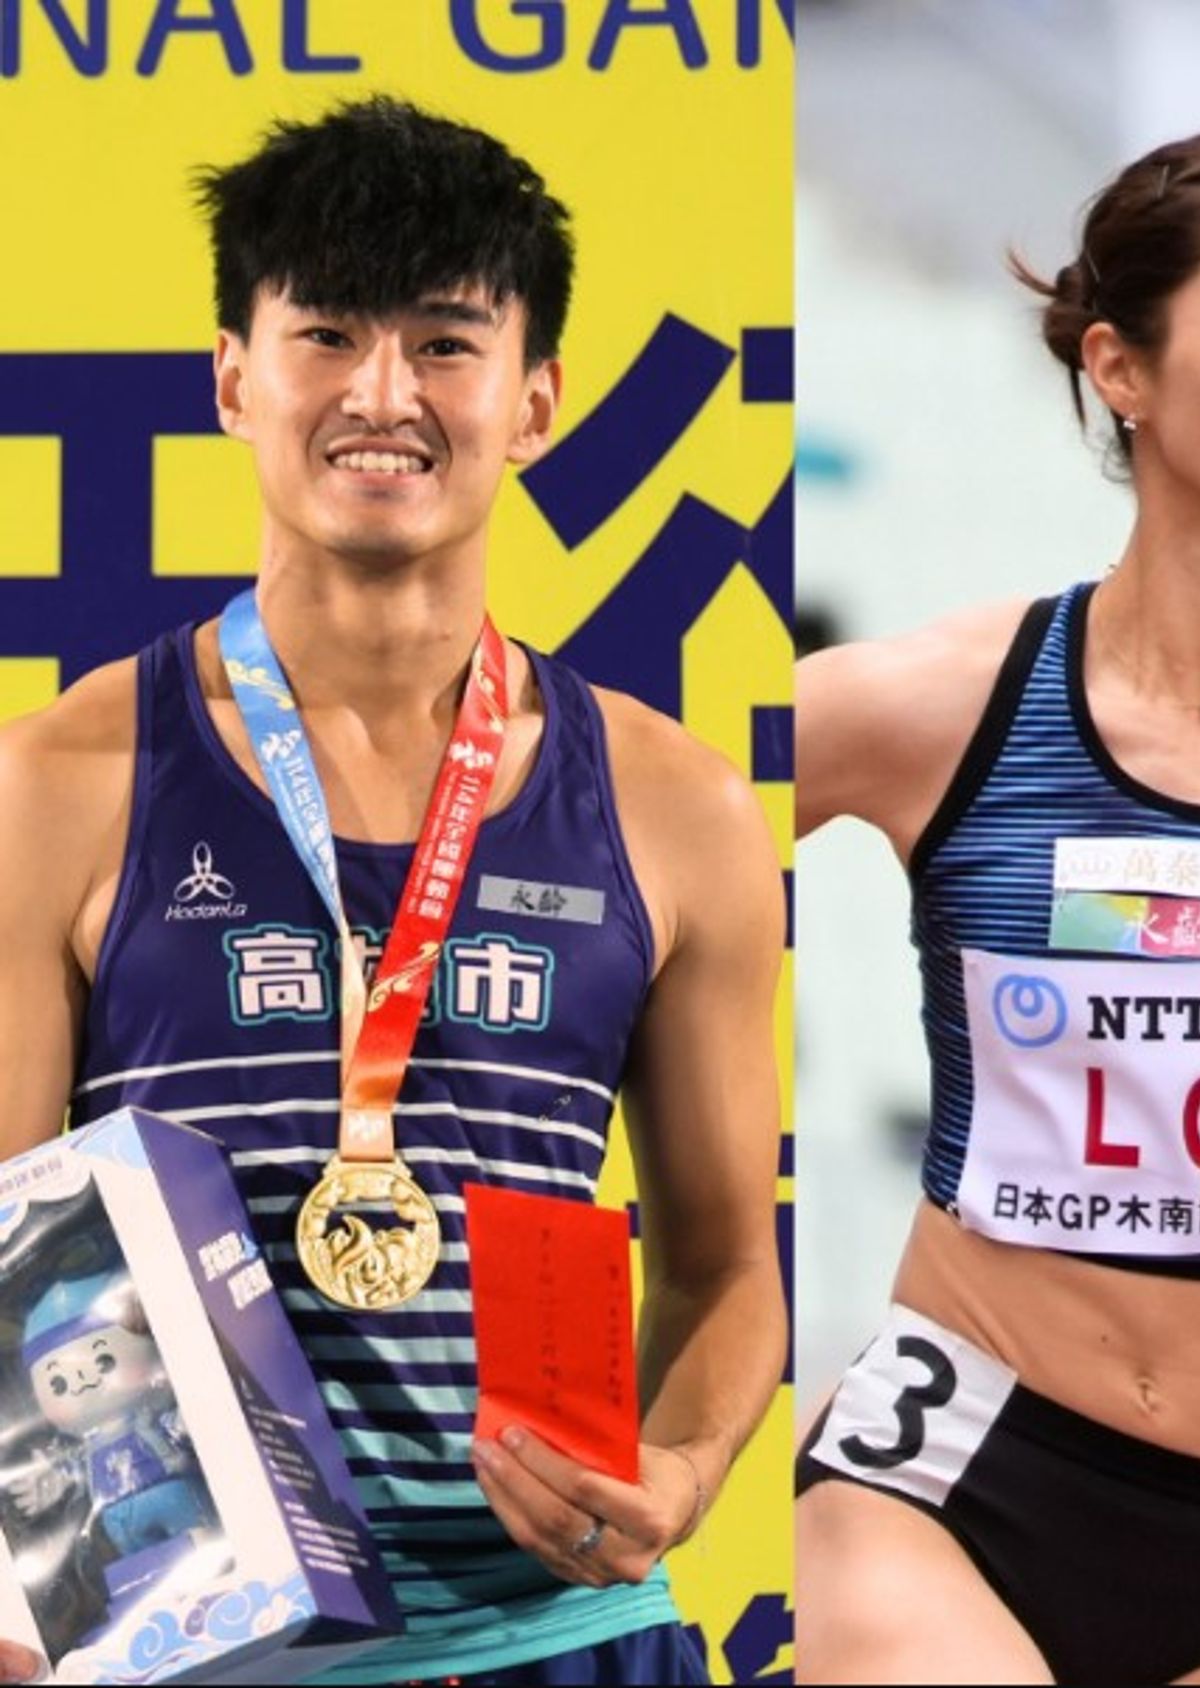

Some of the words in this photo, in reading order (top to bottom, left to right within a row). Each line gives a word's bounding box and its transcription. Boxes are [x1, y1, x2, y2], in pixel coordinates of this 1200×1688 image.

[447, 0, 793, 74] GA
[226, 924, 552, 1030] 高市
[839, 1335, 957, 1470] 3
